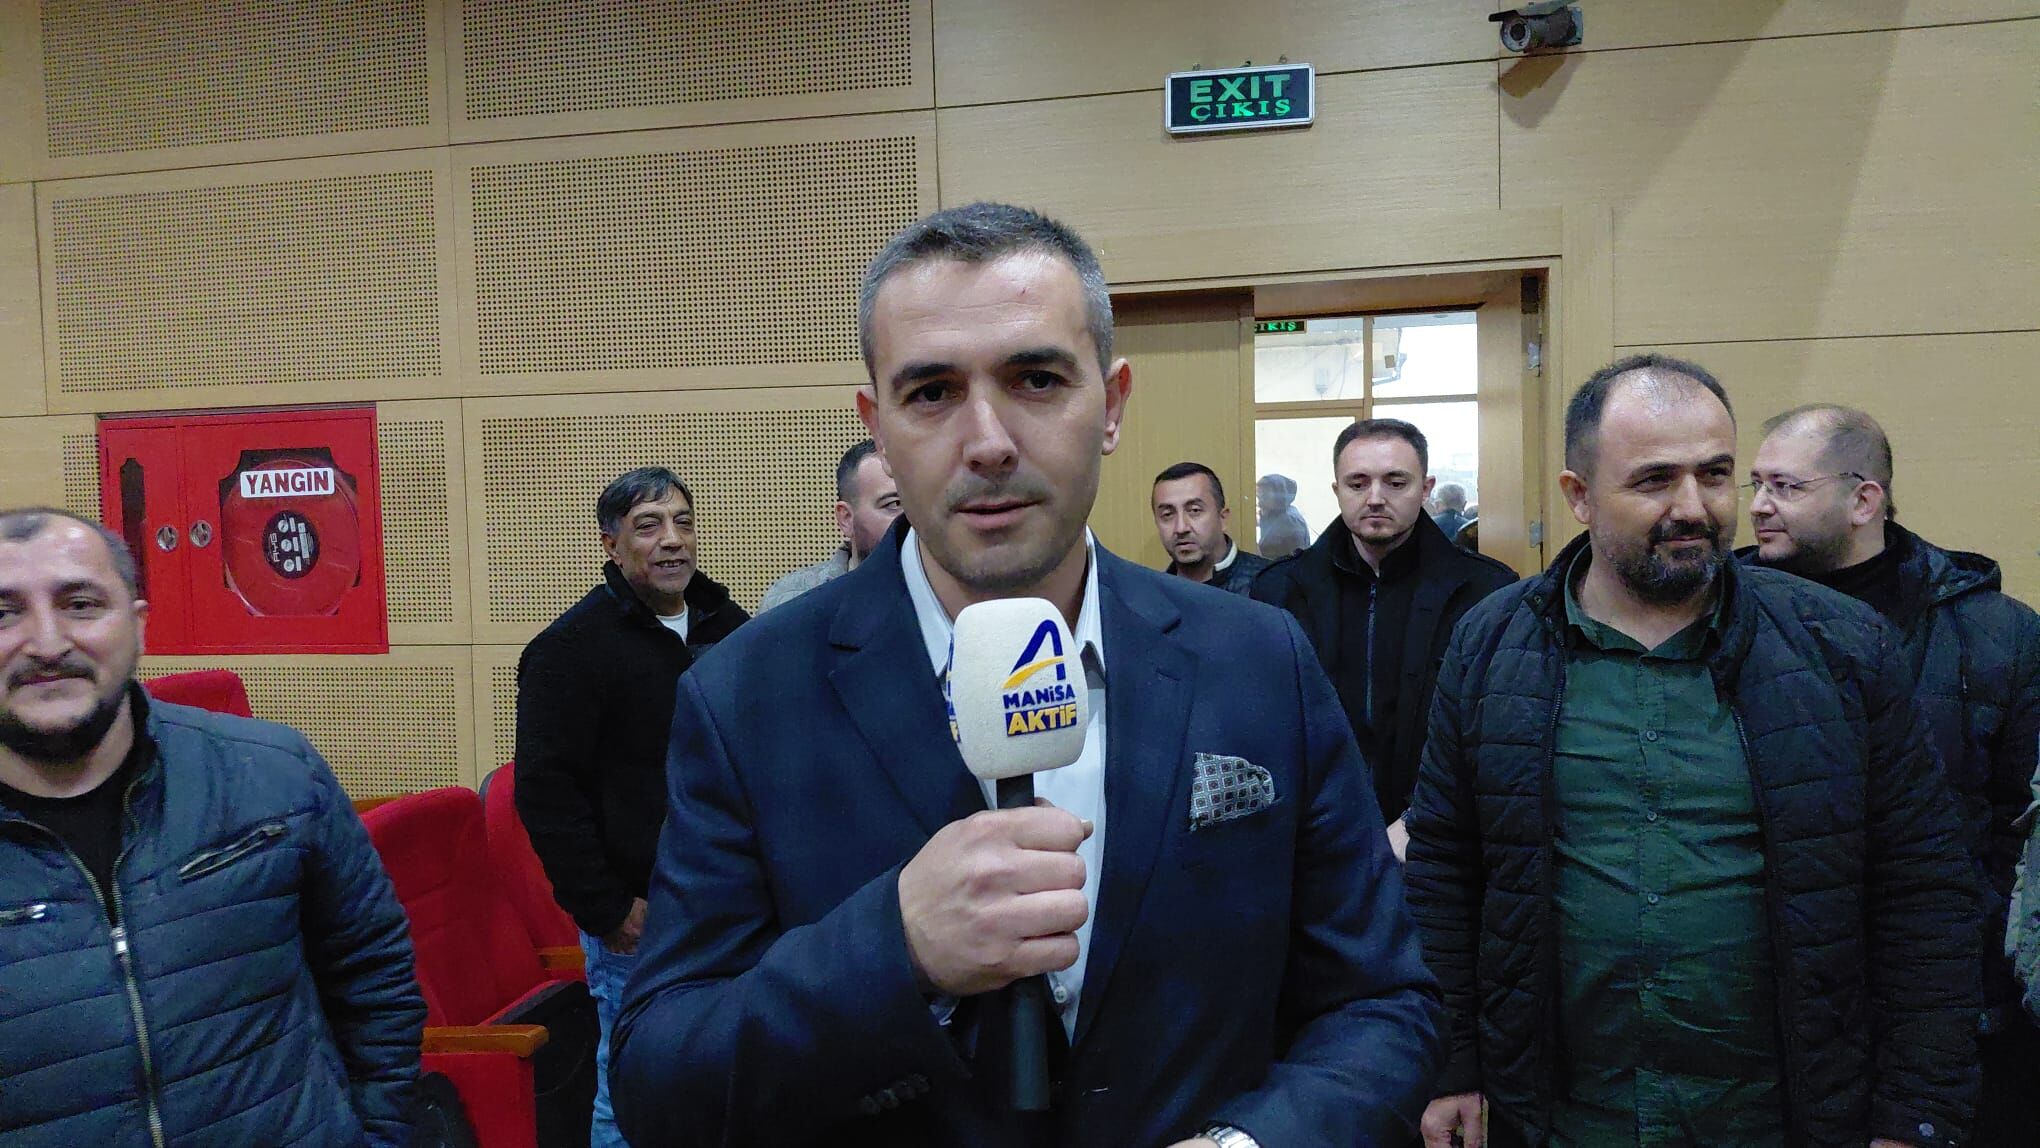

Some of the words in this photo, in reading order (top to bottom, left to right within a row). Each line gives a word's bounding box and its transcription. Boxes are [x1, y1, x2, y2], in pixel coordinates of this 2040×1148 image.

[1190, 74, 1290, 103] EXIT
[1190, 99, 1291, 121] ÇIKIŞ
[246, 470, 329, 495] YANGIN
